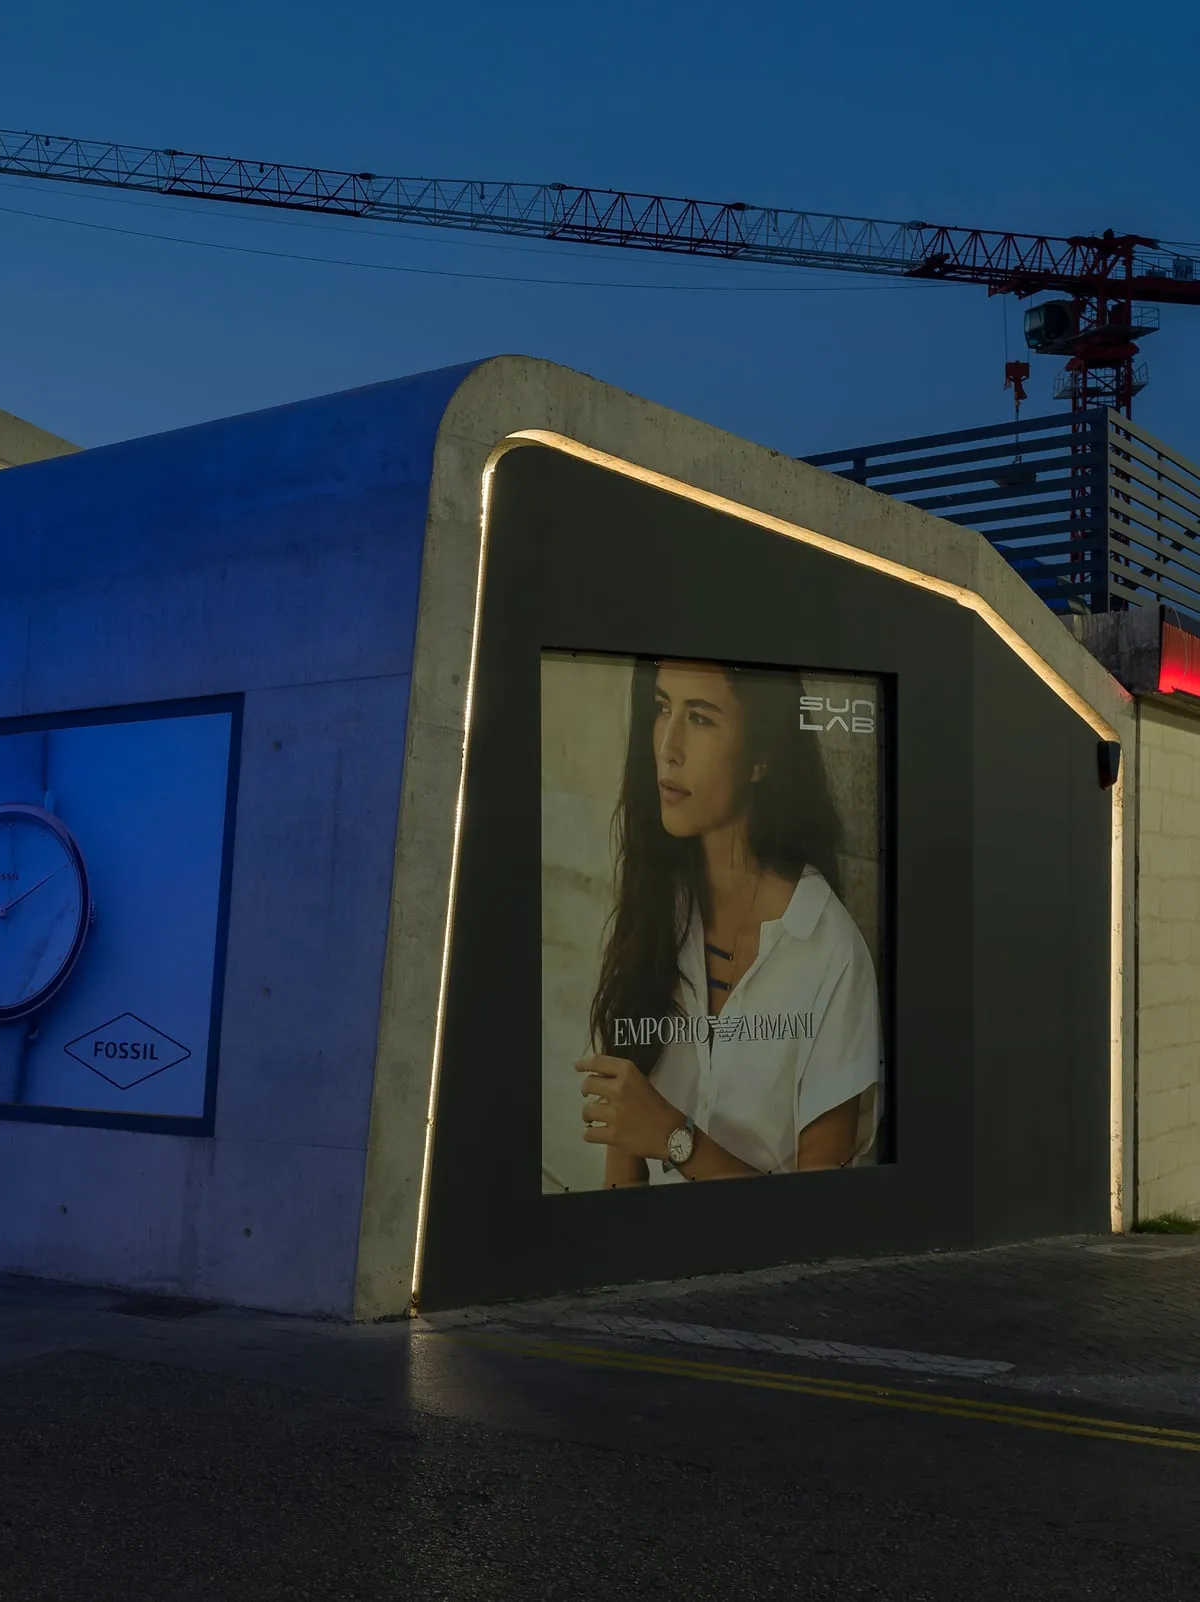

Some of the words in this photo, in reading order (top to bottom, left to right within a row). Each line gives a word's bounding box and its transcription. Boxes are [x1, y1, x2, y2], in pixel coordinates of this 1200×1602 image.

[800, 696, 875, 715] SUN
[800, 714, 875, 733] LAB
[614, 1015, 710, 1046] EMPORIO
[738, 1012, 815, 1041] ARMANI
[93, 1041, 158, 1060] FOSSIL
